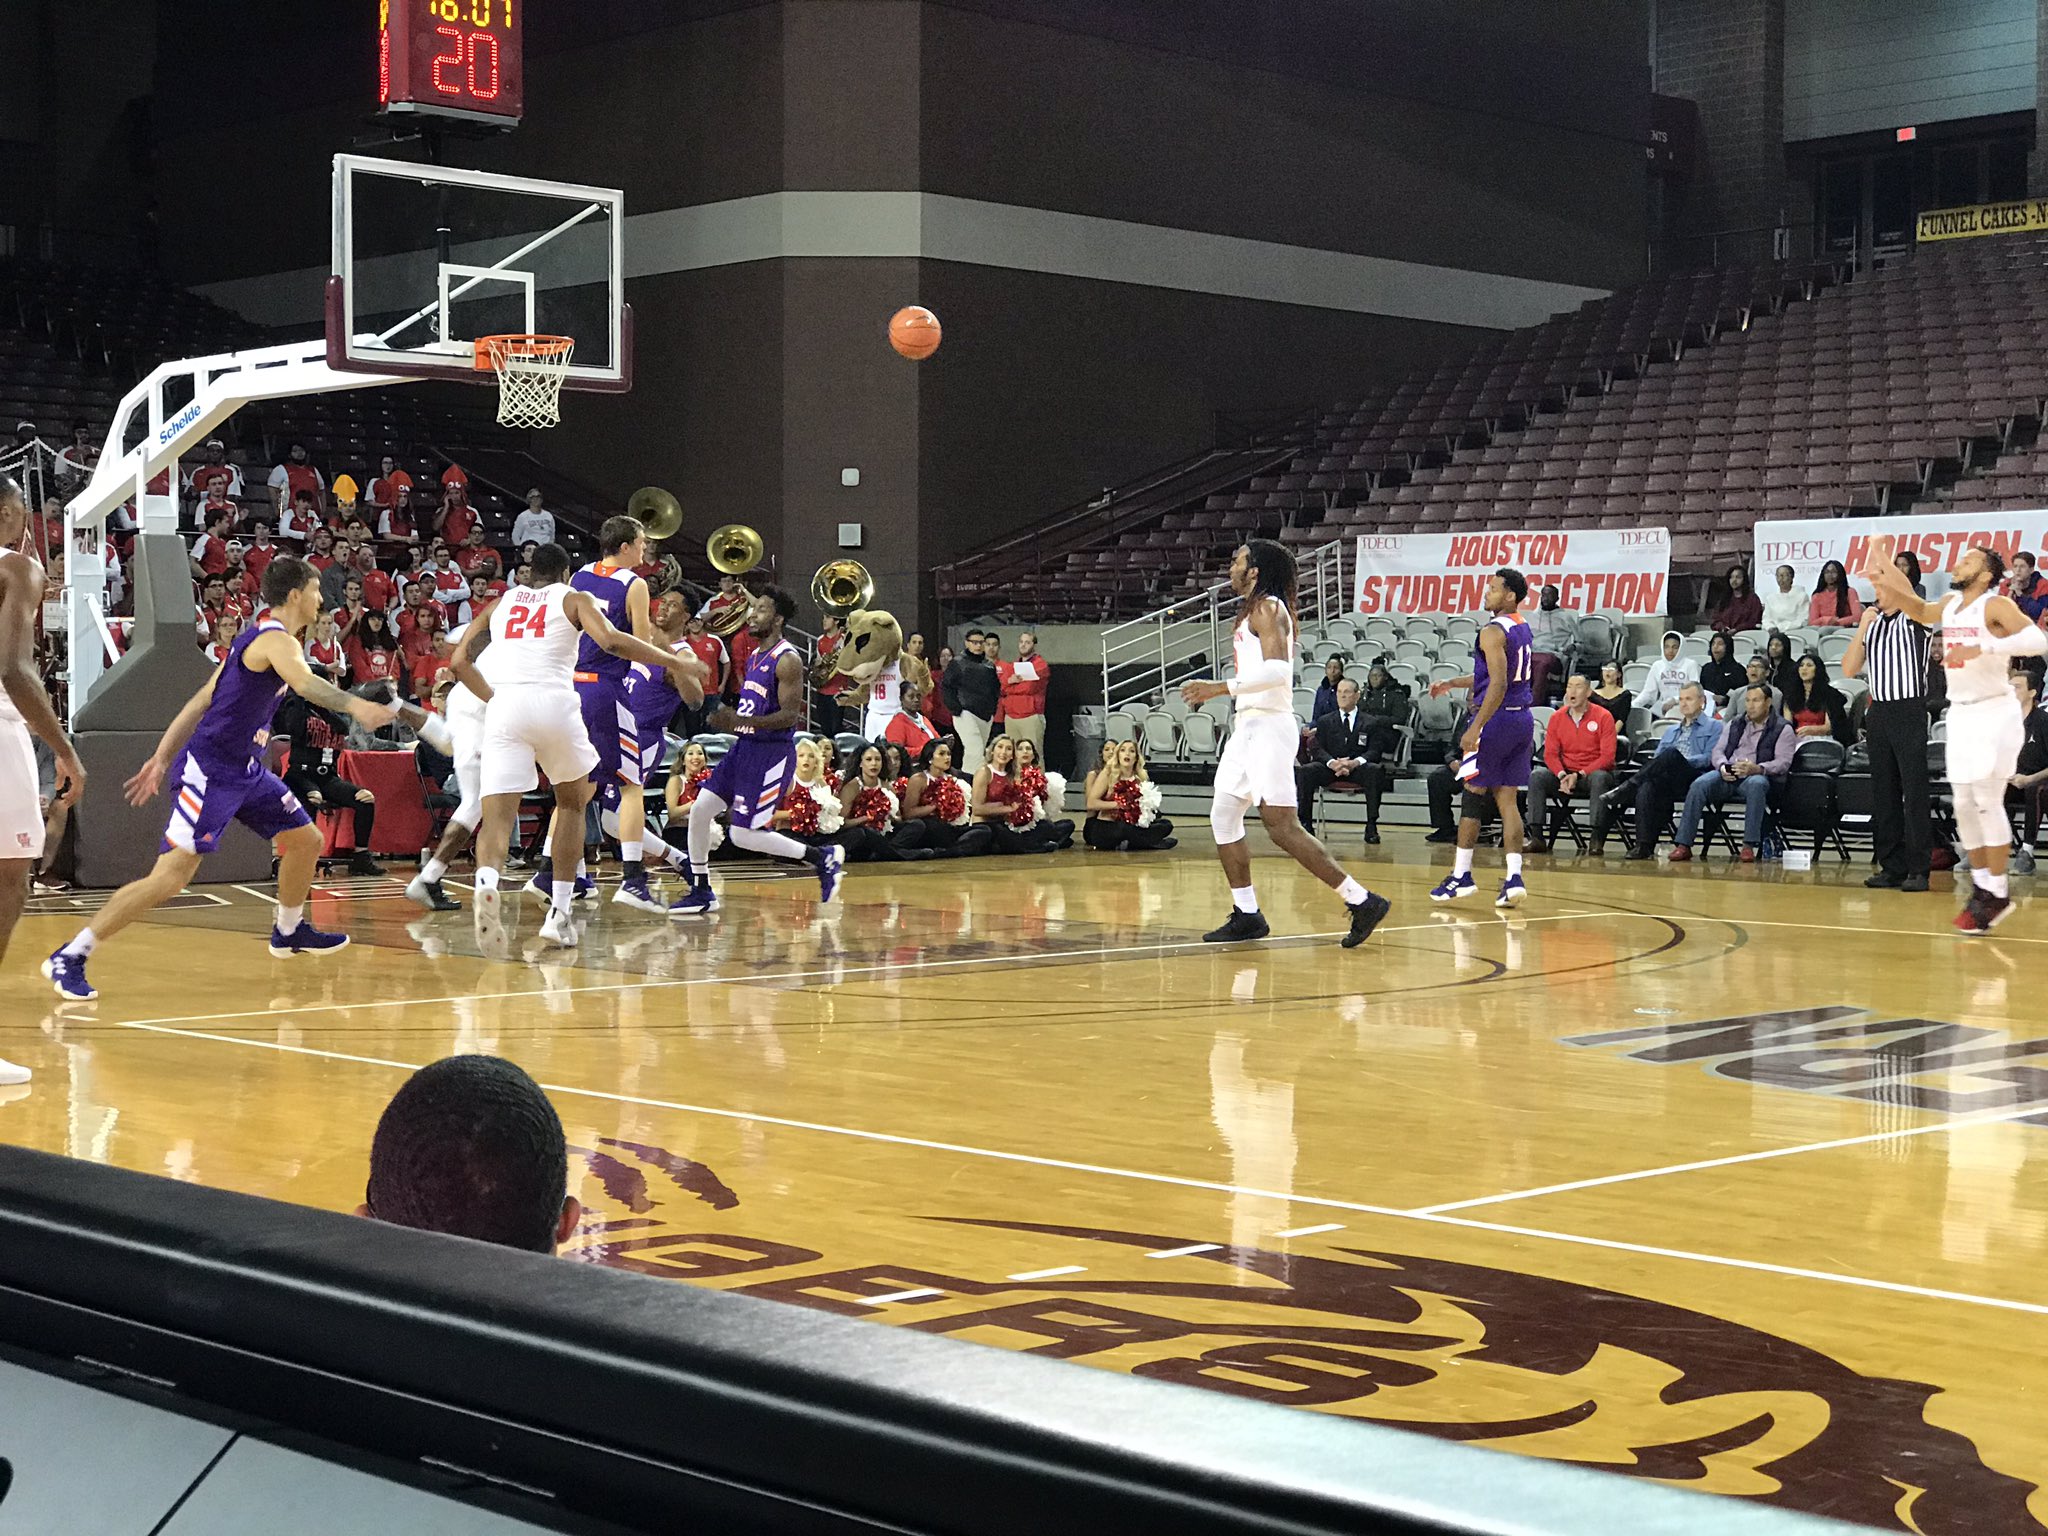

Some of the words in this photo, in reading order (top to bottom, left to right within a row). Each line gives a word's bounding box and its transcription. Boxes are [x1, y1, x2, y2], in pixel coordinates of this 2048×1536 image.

[433, 25, 498, 99] 20
[1920, 210, 1978, 236] FUNNEL
[1981, 203, 2028, 230] CAKES
[160, 405, 201, 444] Schelde
[1361, 536, 1403, 549] TDECU
[1618, 531, 1667, 545] TDECU
[1446, 534, 1569, 567] HOUSTON
[1761, 540, 1835, 561] TDECU
[515, 590, 550, 604] BRADY
[504, 604, 548, 639] 24
[1660, 671, 1686, 680] AERO
[875, 683, 886, 699] 18
[736, 698, 755, 717] 22
